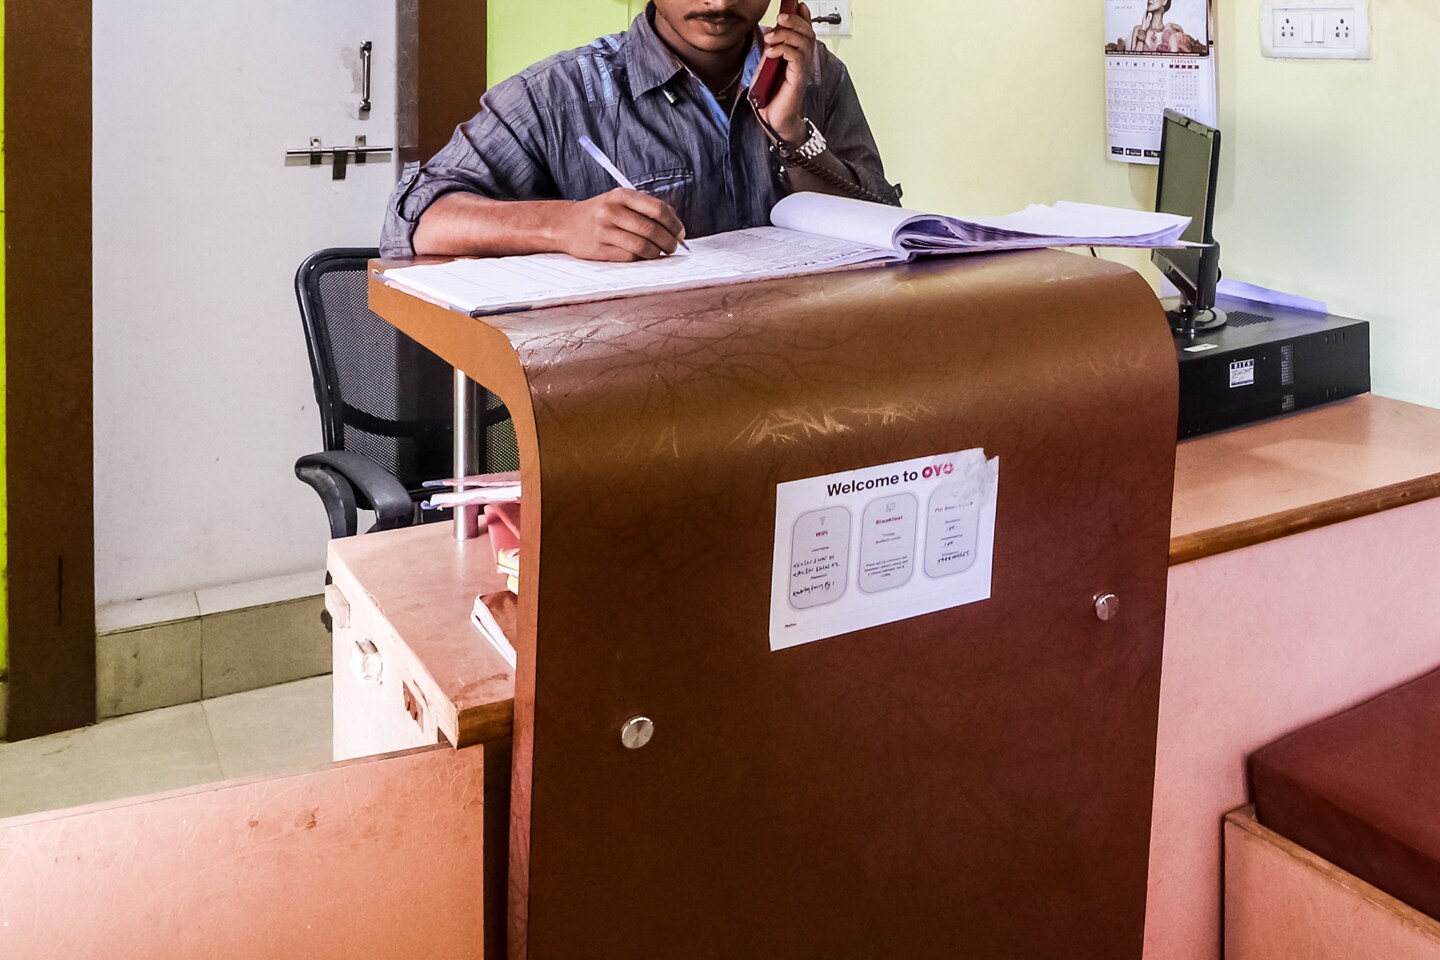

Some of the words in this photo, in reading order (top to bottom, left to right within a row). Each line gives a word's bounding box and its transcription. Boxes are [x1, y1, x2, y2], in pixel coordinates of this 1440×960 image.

[827, 474, 899, 497] Welcome
[903, 470, 918, 482] to
[921, 462, 954, 479] OYO
